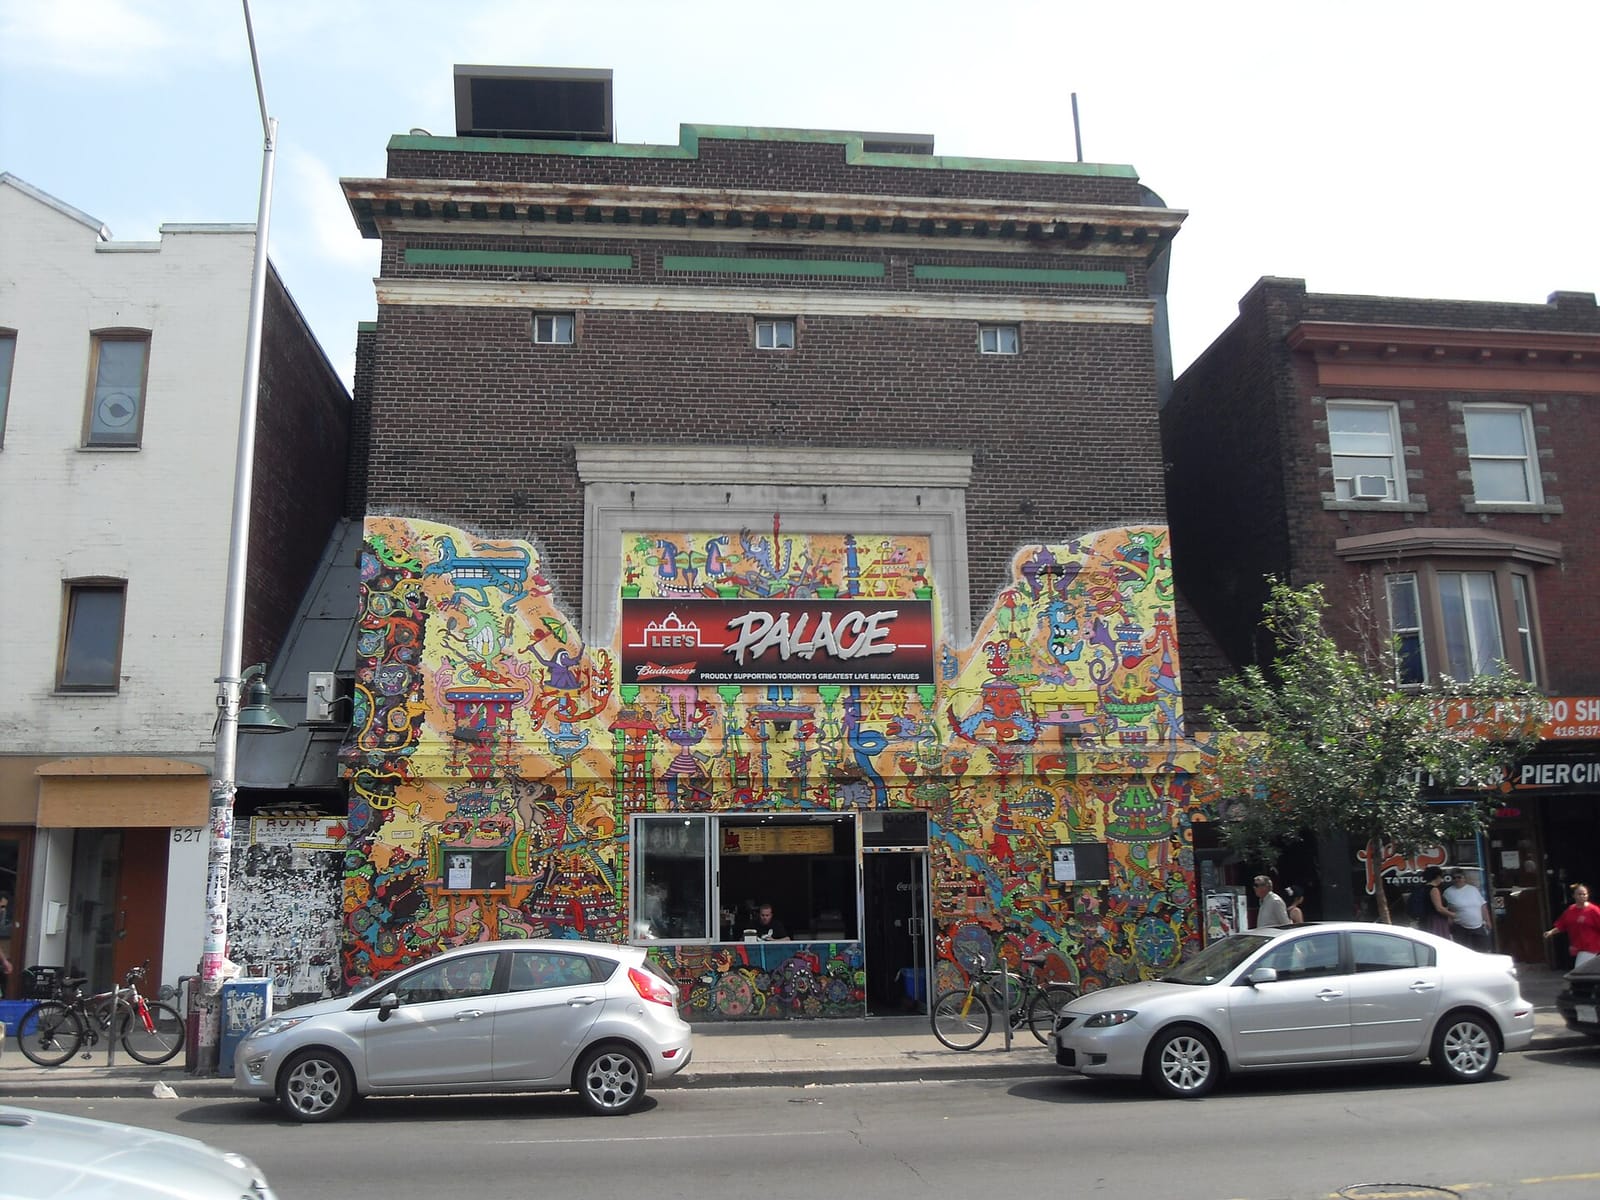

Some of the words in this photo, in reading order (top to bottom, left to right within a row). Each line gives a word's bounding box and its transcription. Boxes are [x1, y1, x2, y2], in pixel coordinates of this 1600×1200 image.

[651, 634, 695, 648] LEE'S
[724, 609, 898, 666] PALACE
[635, 664, 697, 676] Budweiser
[700, 672, 734, 680] PROUDLY
[734, 672, 777, 680] SUPPORTING
[778, 672, 817, 680] TORONTO'S
[818, 672, 854, 680] GREATEST
[854, 672, 869, 680] LIVE
[870, 672, 892, 680] MUSIC
[892, 672, 920, 680] VENUES
[174, 828, 202, 842] 527
